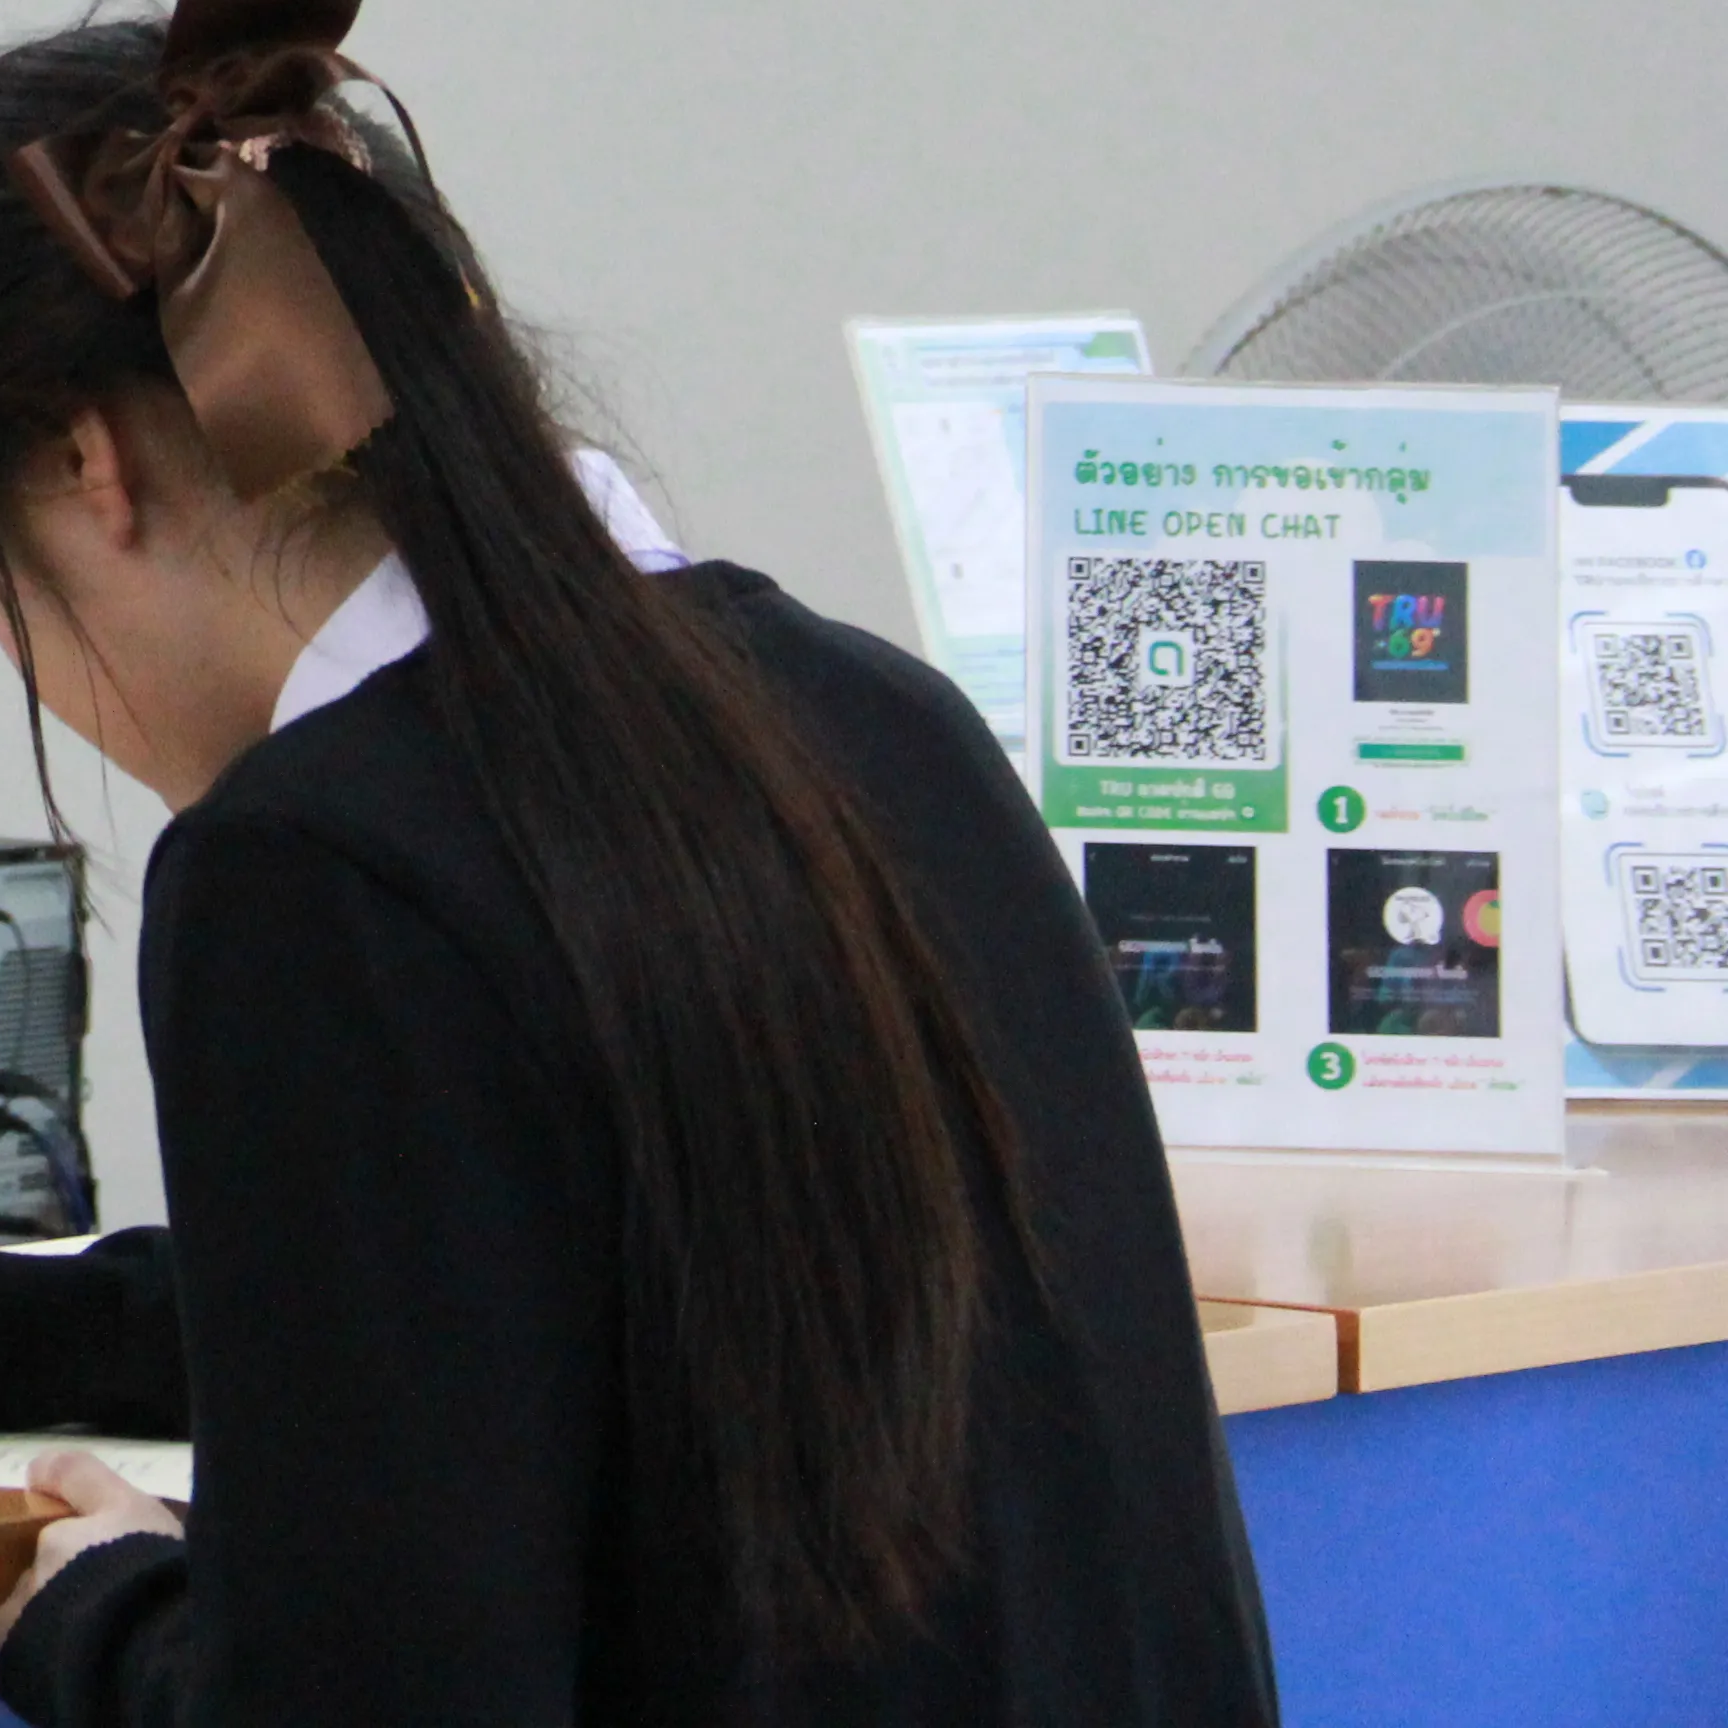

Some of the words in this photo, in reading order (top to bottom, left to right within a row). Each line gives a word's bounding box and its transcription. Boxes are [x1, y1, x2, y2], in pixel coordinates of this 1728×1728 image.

[1074, 437, 1198, 487] ตัวอย่าง
[1212, 439, 1430, 504] การขอเข้ากลุ่ม
[1074, 508, 1148, 536] LINE
[1162, 510, 1244, 538] OPEN
[1260, 512, 1341, 539] CHAT
[1368, 594, 1446, 631] TRU
[1388, 627, 1434, 658] 69
[1333, 795, 1349, 825] 1
[1320, 1052, 1341, 1081] 3
